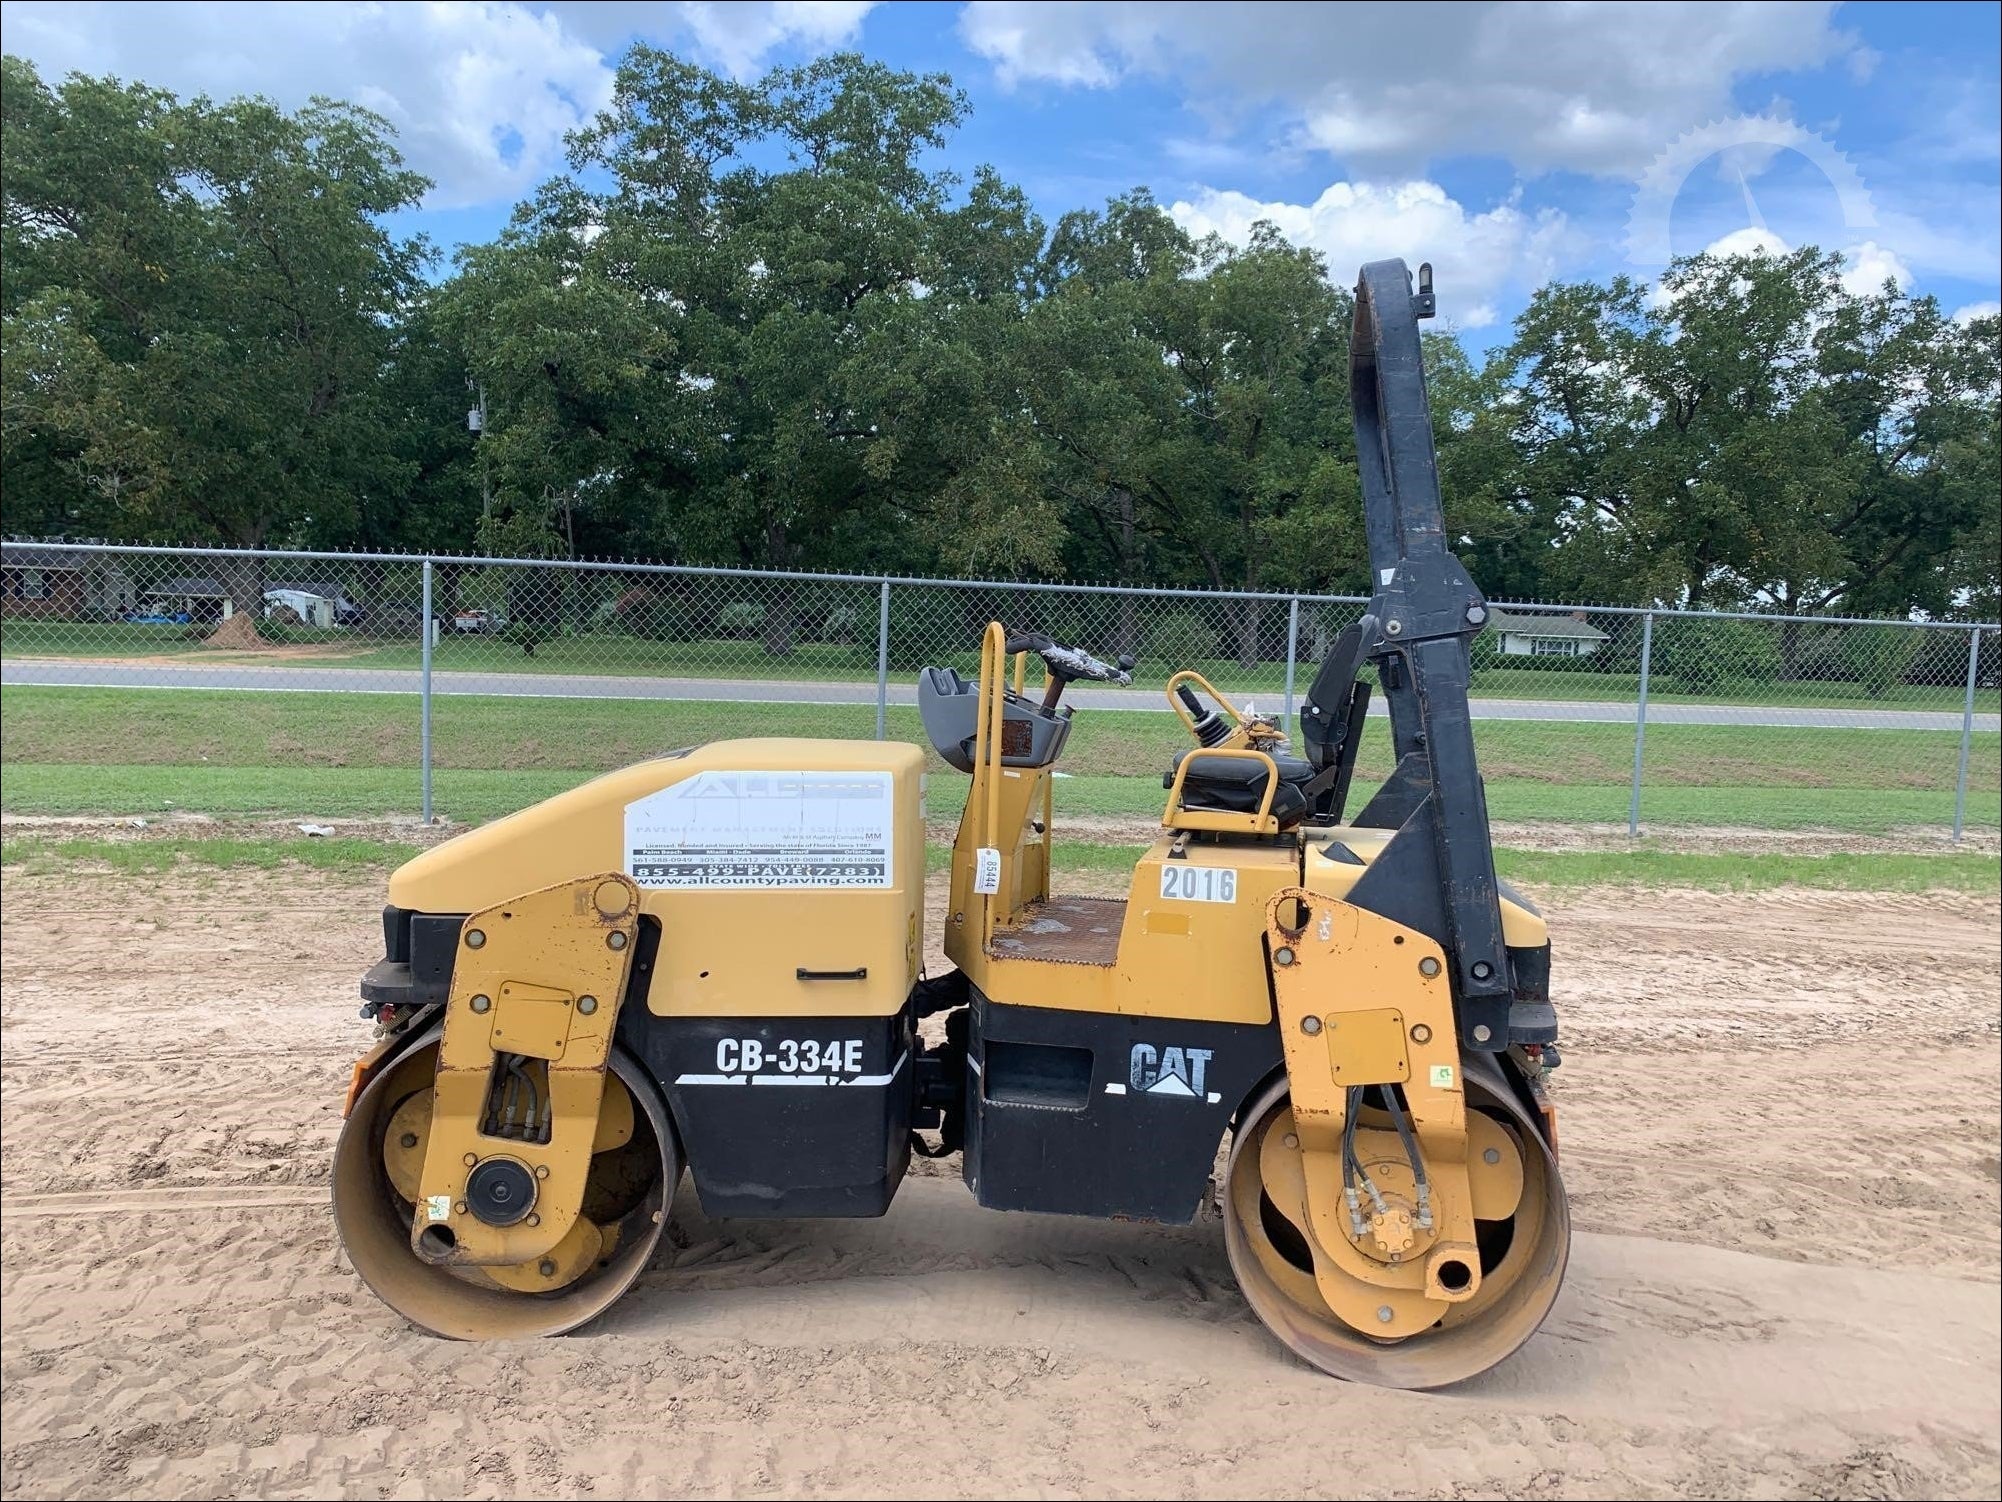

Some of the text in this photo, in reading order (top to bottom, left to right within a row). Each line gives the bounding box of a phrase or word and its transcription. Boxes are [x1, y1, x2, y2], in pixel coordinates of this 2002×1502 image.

[635, 876, 884, 886] www.allcountypaving.com
[637, 867, 881, 876] 855-499-PAVE(7283)
[985, 861, 997, 887] 85444
[1162, 866, 1235, 901] 2016
[716, 1038, 863, 1073] CB-334E
[1129, 1043, 1214, 1097] CAT
